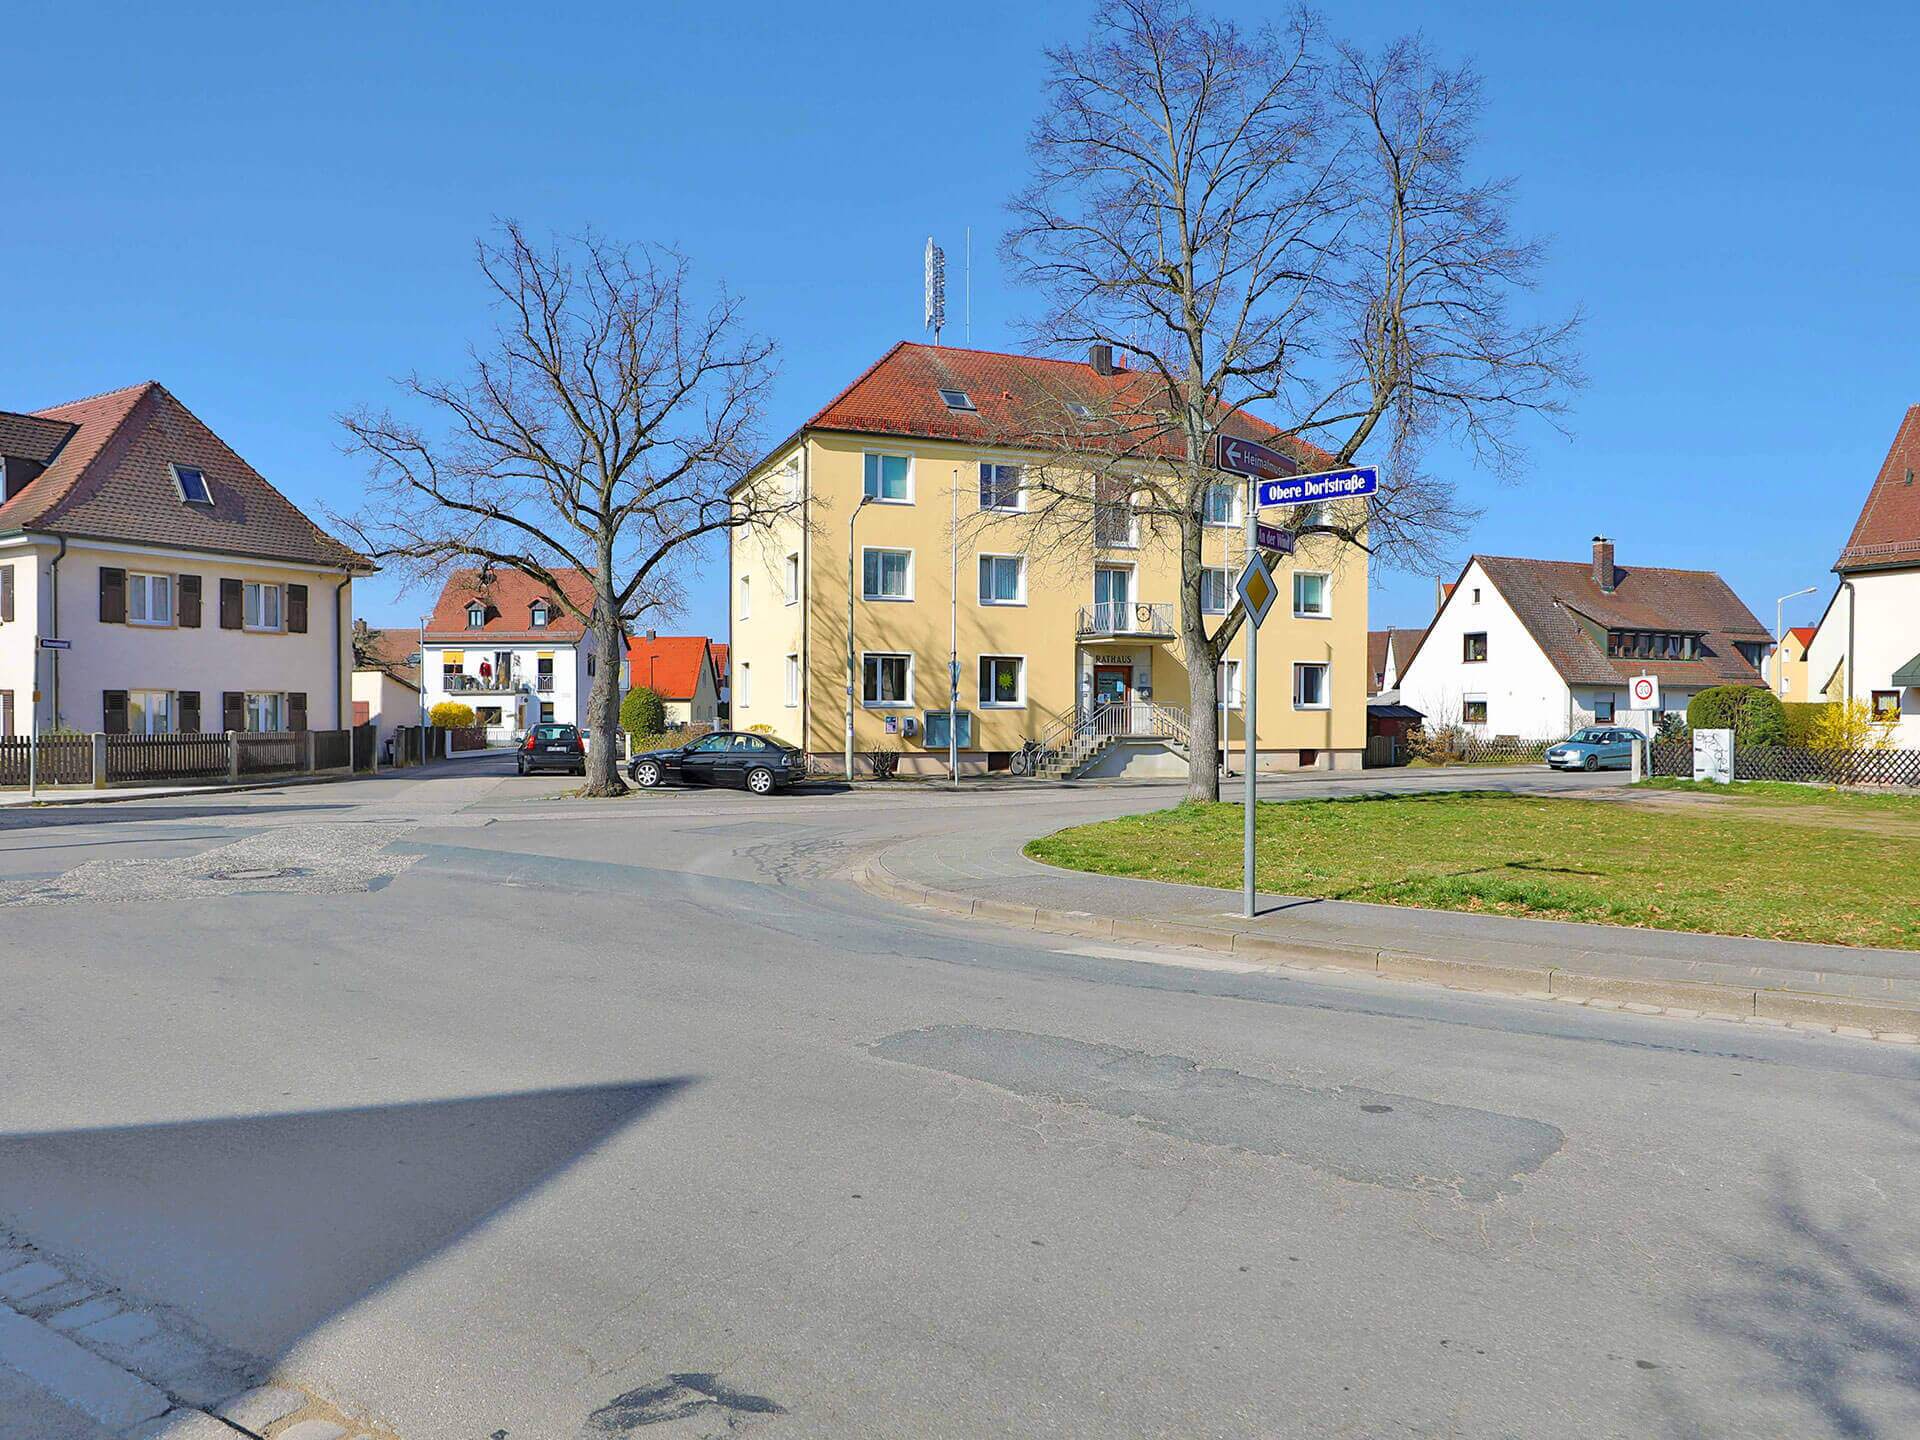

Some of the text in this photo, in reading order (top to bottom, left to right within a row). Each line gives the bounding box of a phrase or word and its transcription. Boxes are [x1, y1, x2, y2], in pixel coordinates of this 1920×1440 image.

[1269, 474, 1366, 500] Obere Dorfstraße
[1266, 530, 1275, 545] der
[1095, 655, 1132, 664] RATHAUS
[1639, 684, 1650, 695] 30
